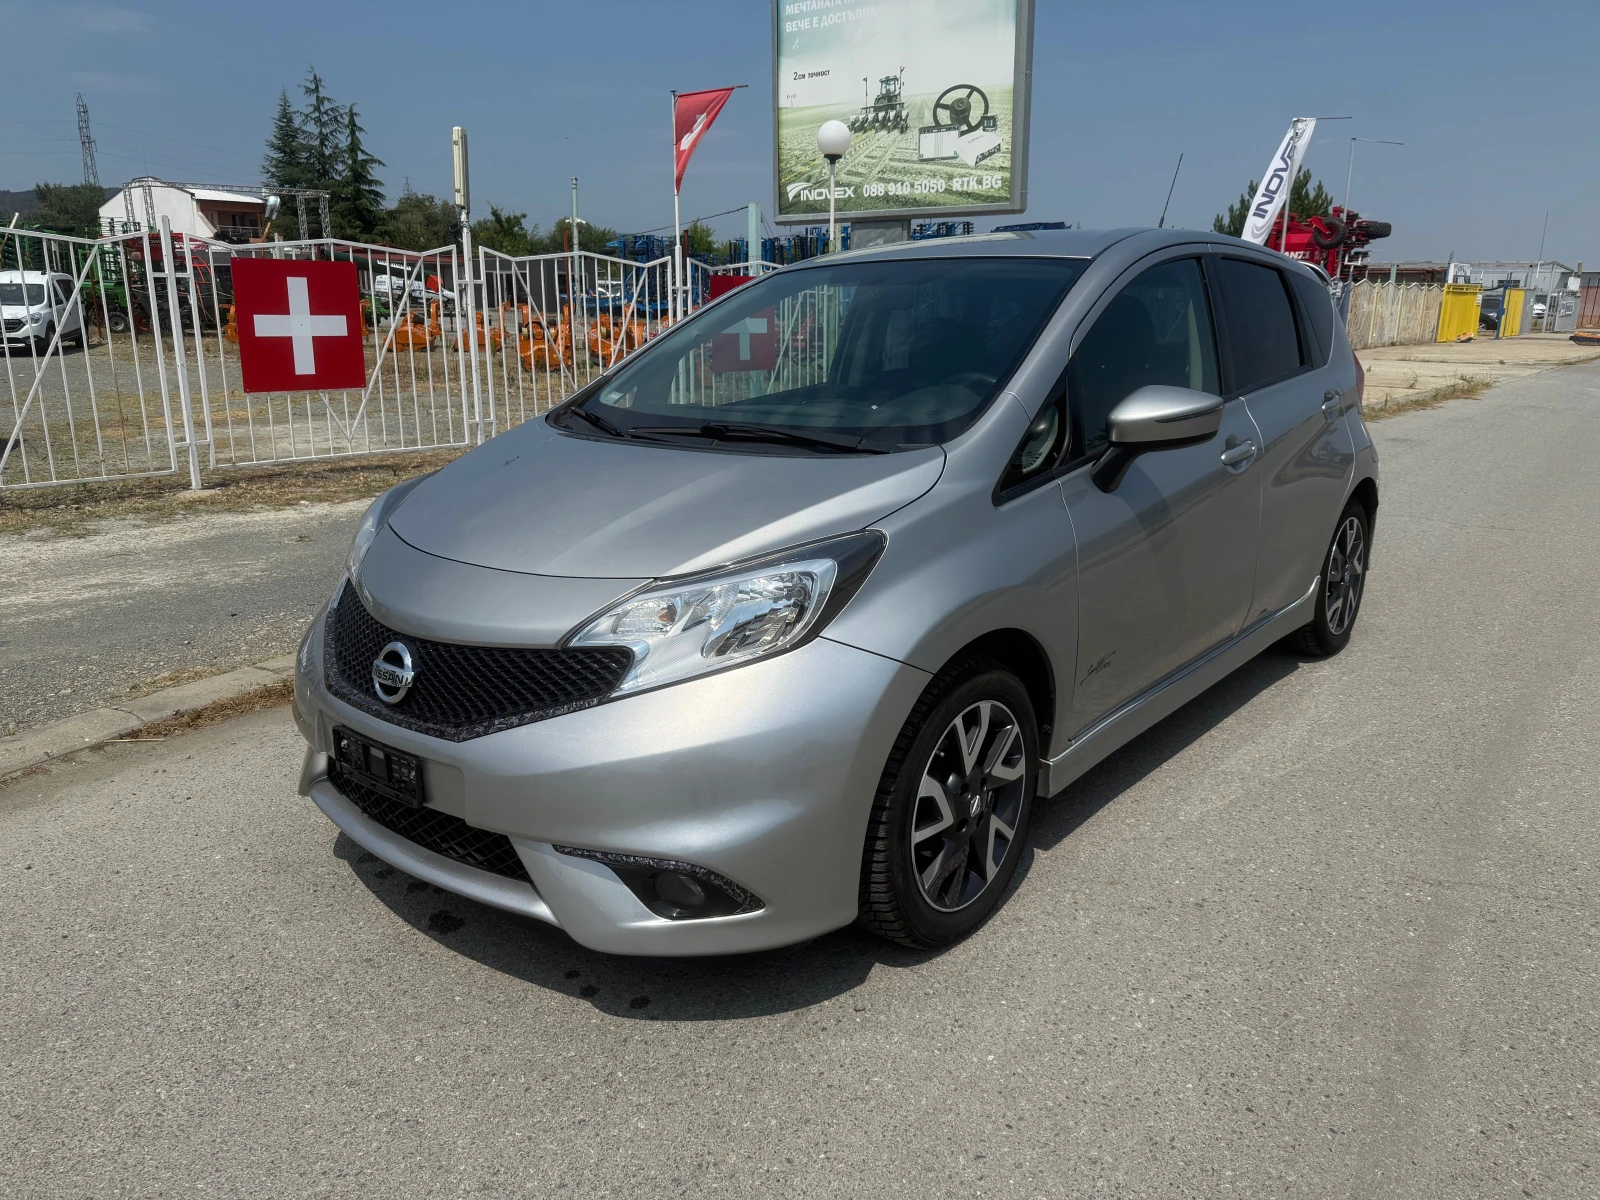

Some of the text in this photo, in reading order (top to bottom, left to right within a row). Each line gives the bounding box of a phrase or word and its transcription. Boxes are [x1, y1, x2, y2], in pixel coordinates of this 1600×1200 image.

[785, 6, 877, 33] ВЕЧЕ Е ДОСТЪПНА
[863, 184, 885, 197] 088
[888, 182, 911, 195] 910
[914, 179, 946, 193] 5050
[952, 175, 1002, 192] RTK.BG
